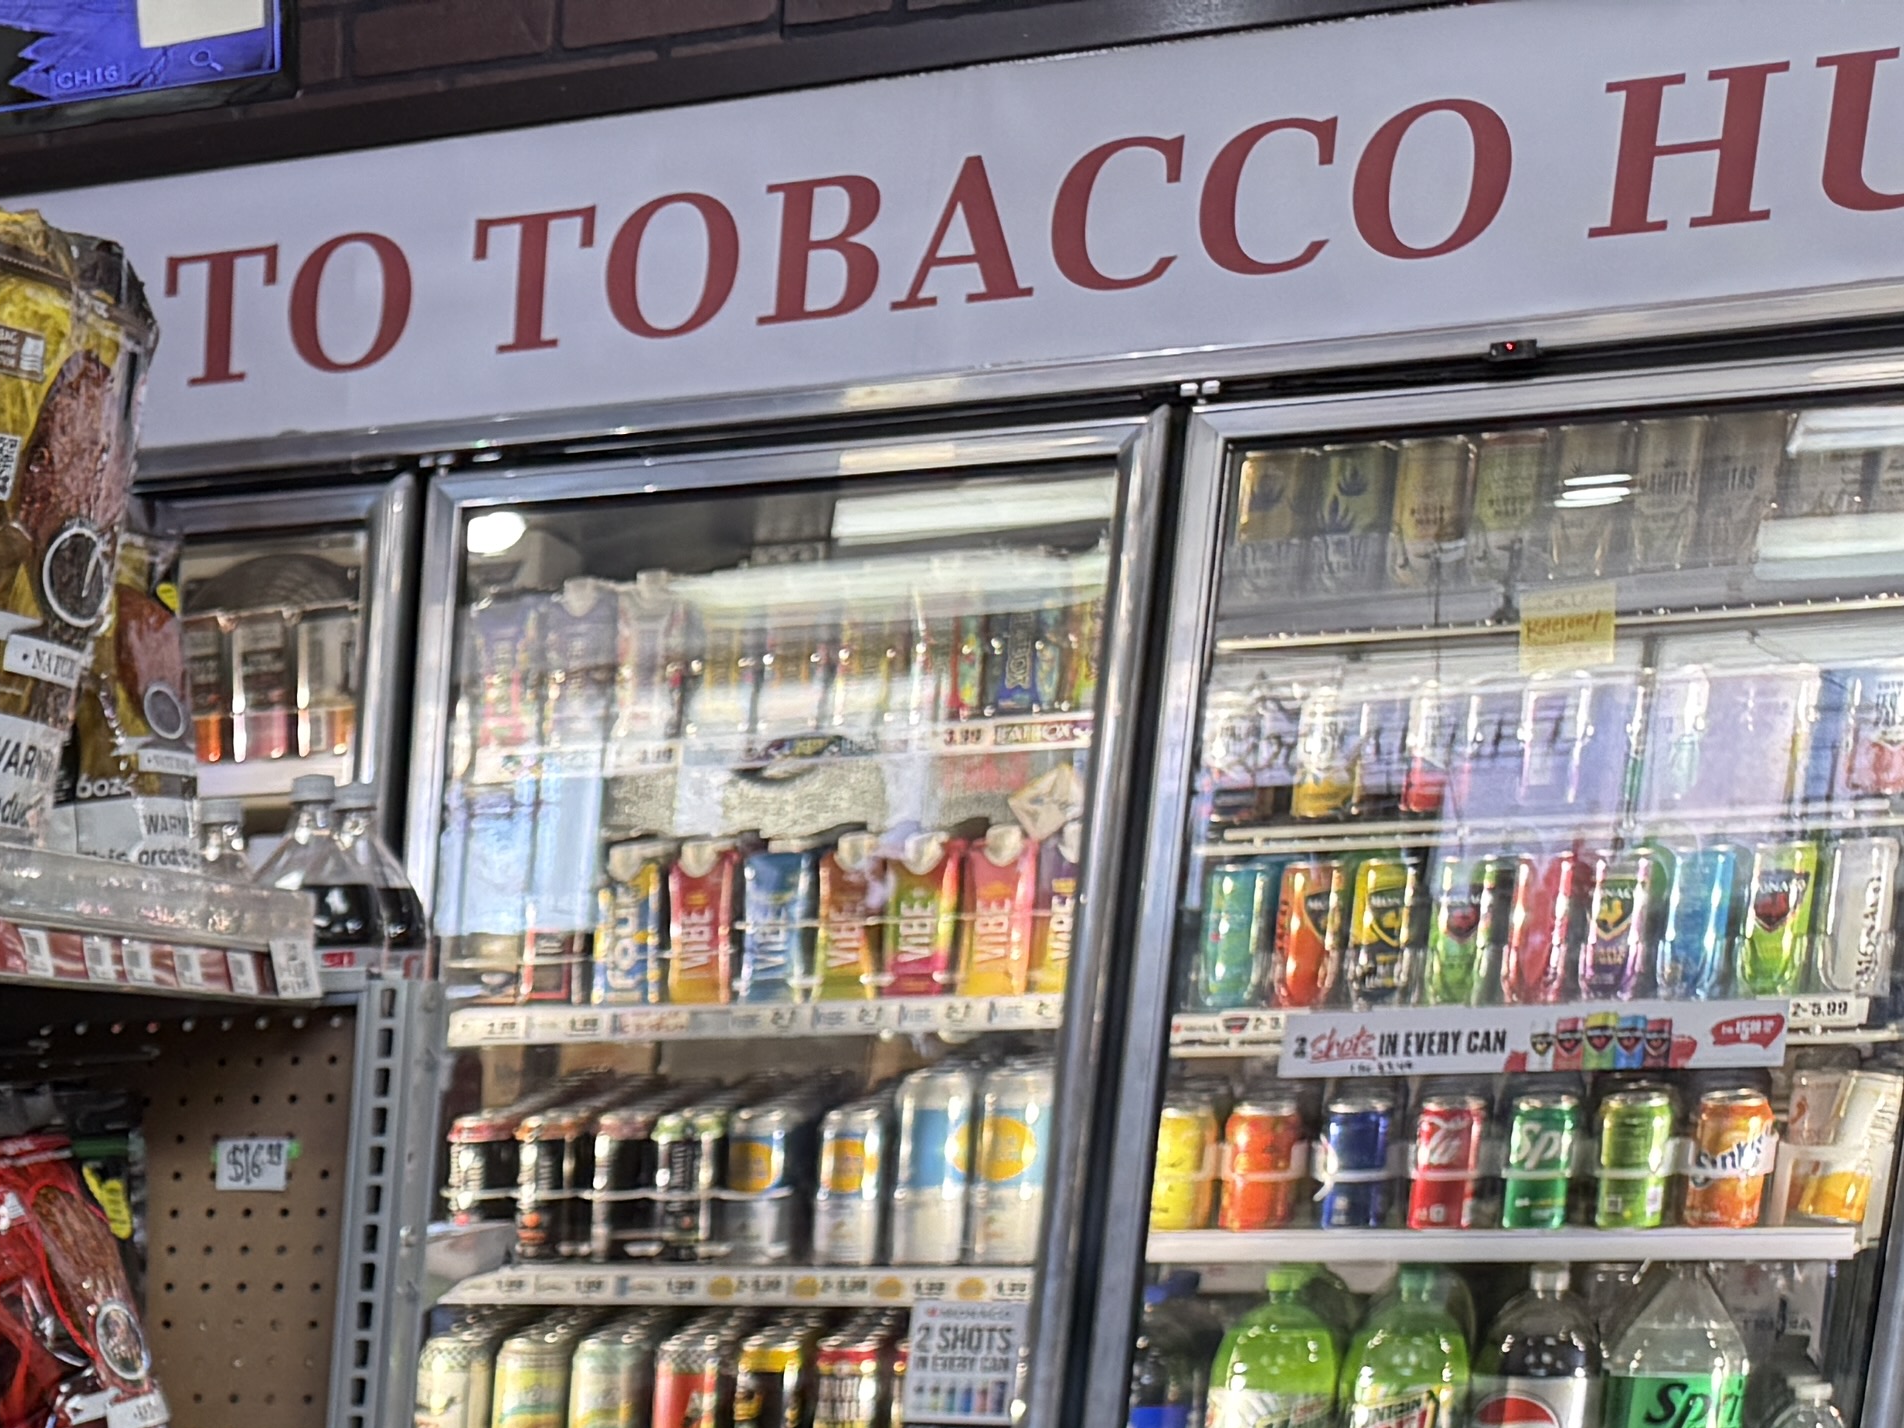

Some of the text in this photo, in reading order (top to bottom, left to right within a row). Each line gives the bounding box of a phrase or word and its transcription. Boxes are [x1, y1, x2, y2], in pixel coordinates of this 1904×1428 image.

[165, 232, 414, 388] TO
[472, 95, 1513, 355] TOBACCO
[899, 901, 937, 962] VIBE
[1377, 1030, 1397, 1055] IN
[1403, 1030, 1461, 1055] EVERY
[1467, 1029, 1507, 1054] CAN
[915, 1324, 1012, 1353] 2 SHOTS
